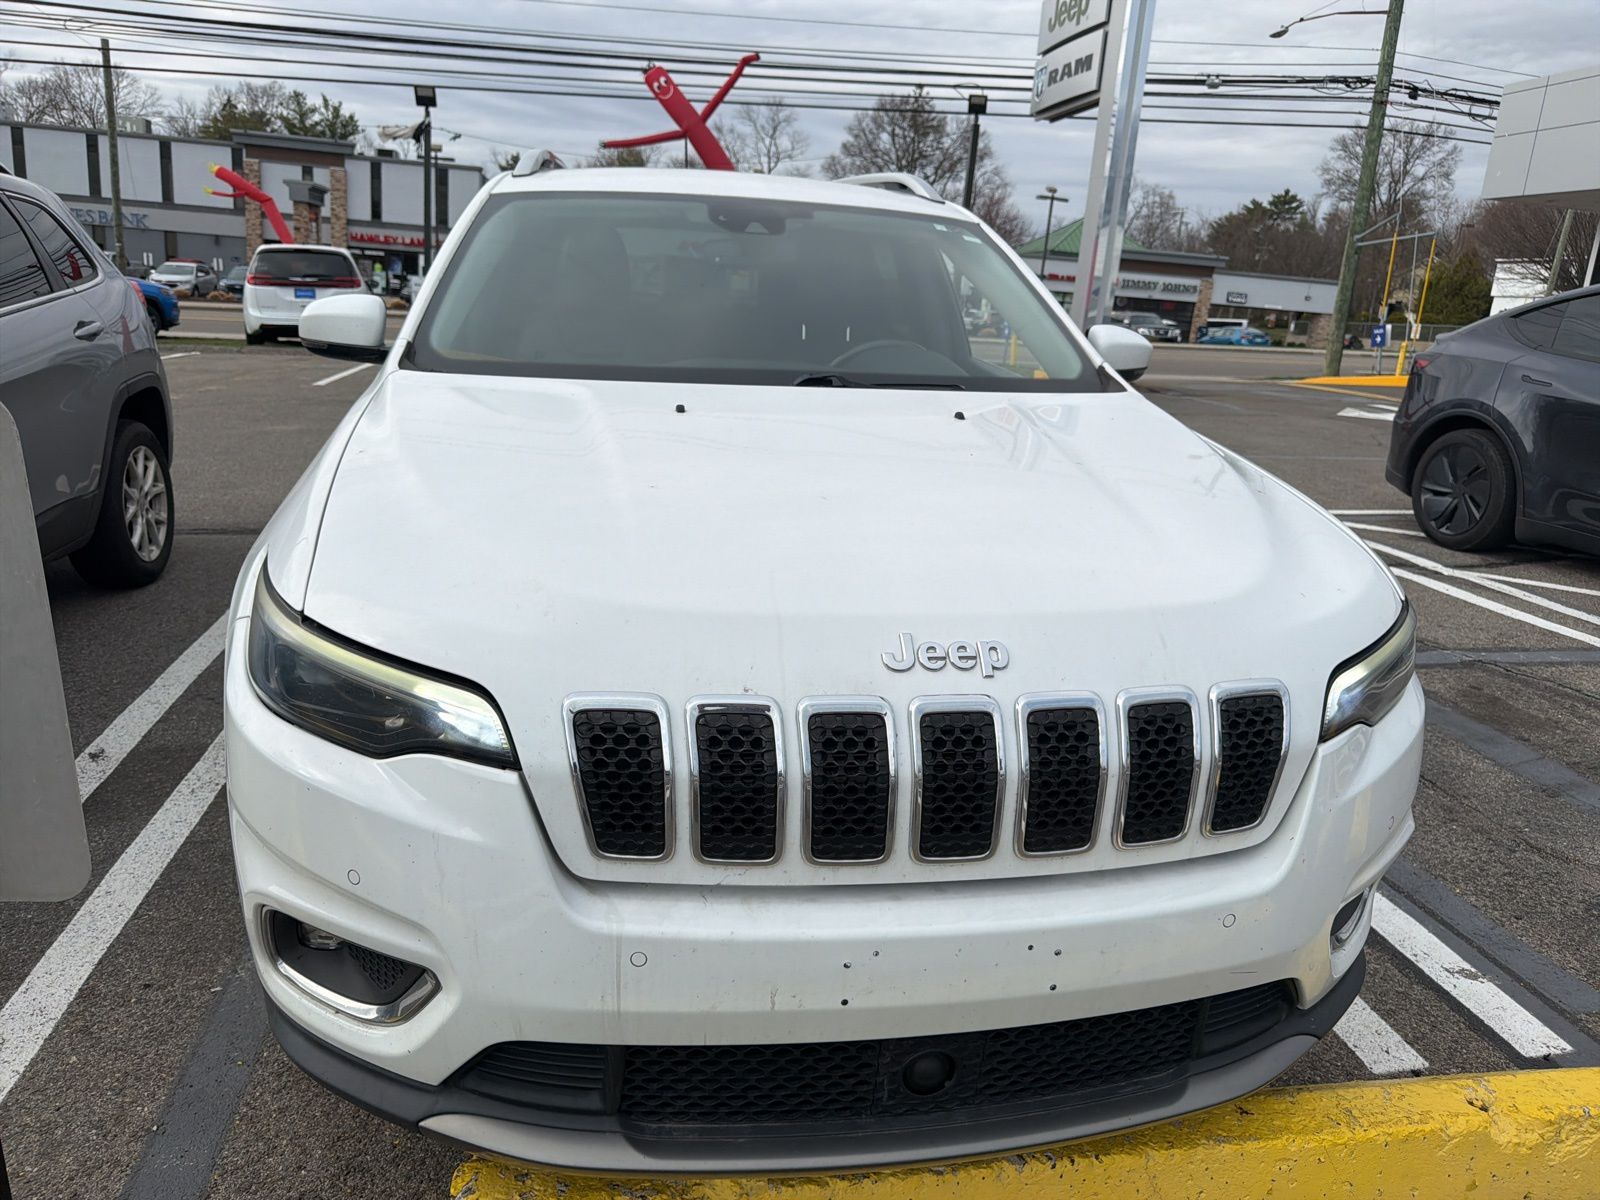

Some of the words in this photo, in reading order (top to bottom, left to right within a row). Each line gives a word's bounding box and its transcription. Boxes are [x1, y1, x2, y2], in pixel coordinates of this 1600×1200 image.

[1048, 0, 1090, 33] Jeep
[1047, 53, 1094, 87] RAM
[349, 231, 399, 246] HAWLEY
[401, 235, 426, 248] LAN
[1121, 278, 1159, 291] JIMMY
[881, 632, 1010, 679] Jeep
